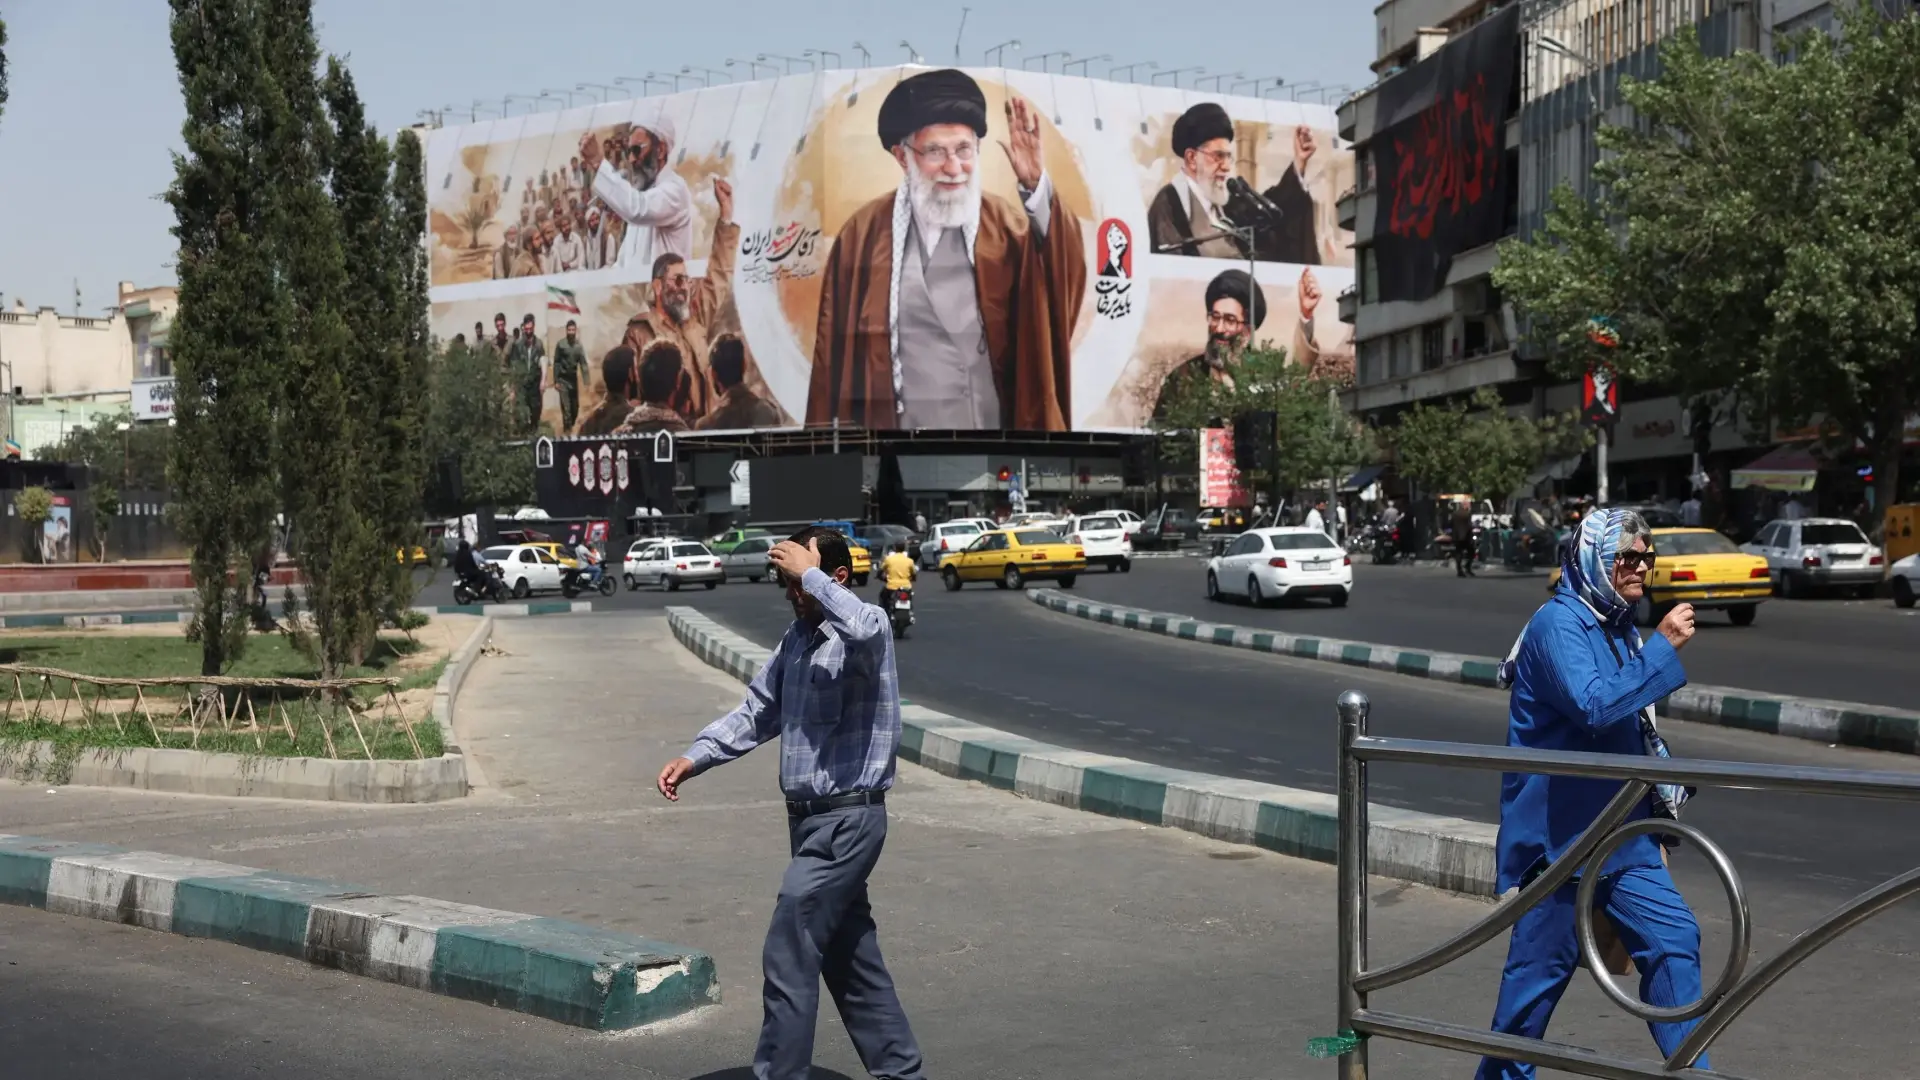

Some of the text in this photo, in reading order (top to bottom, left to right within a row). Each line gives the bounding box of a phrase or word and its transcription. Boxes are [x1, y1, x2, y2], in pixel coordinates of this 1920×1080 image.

[741, 221, 821, 262] آقای شهید ایران
